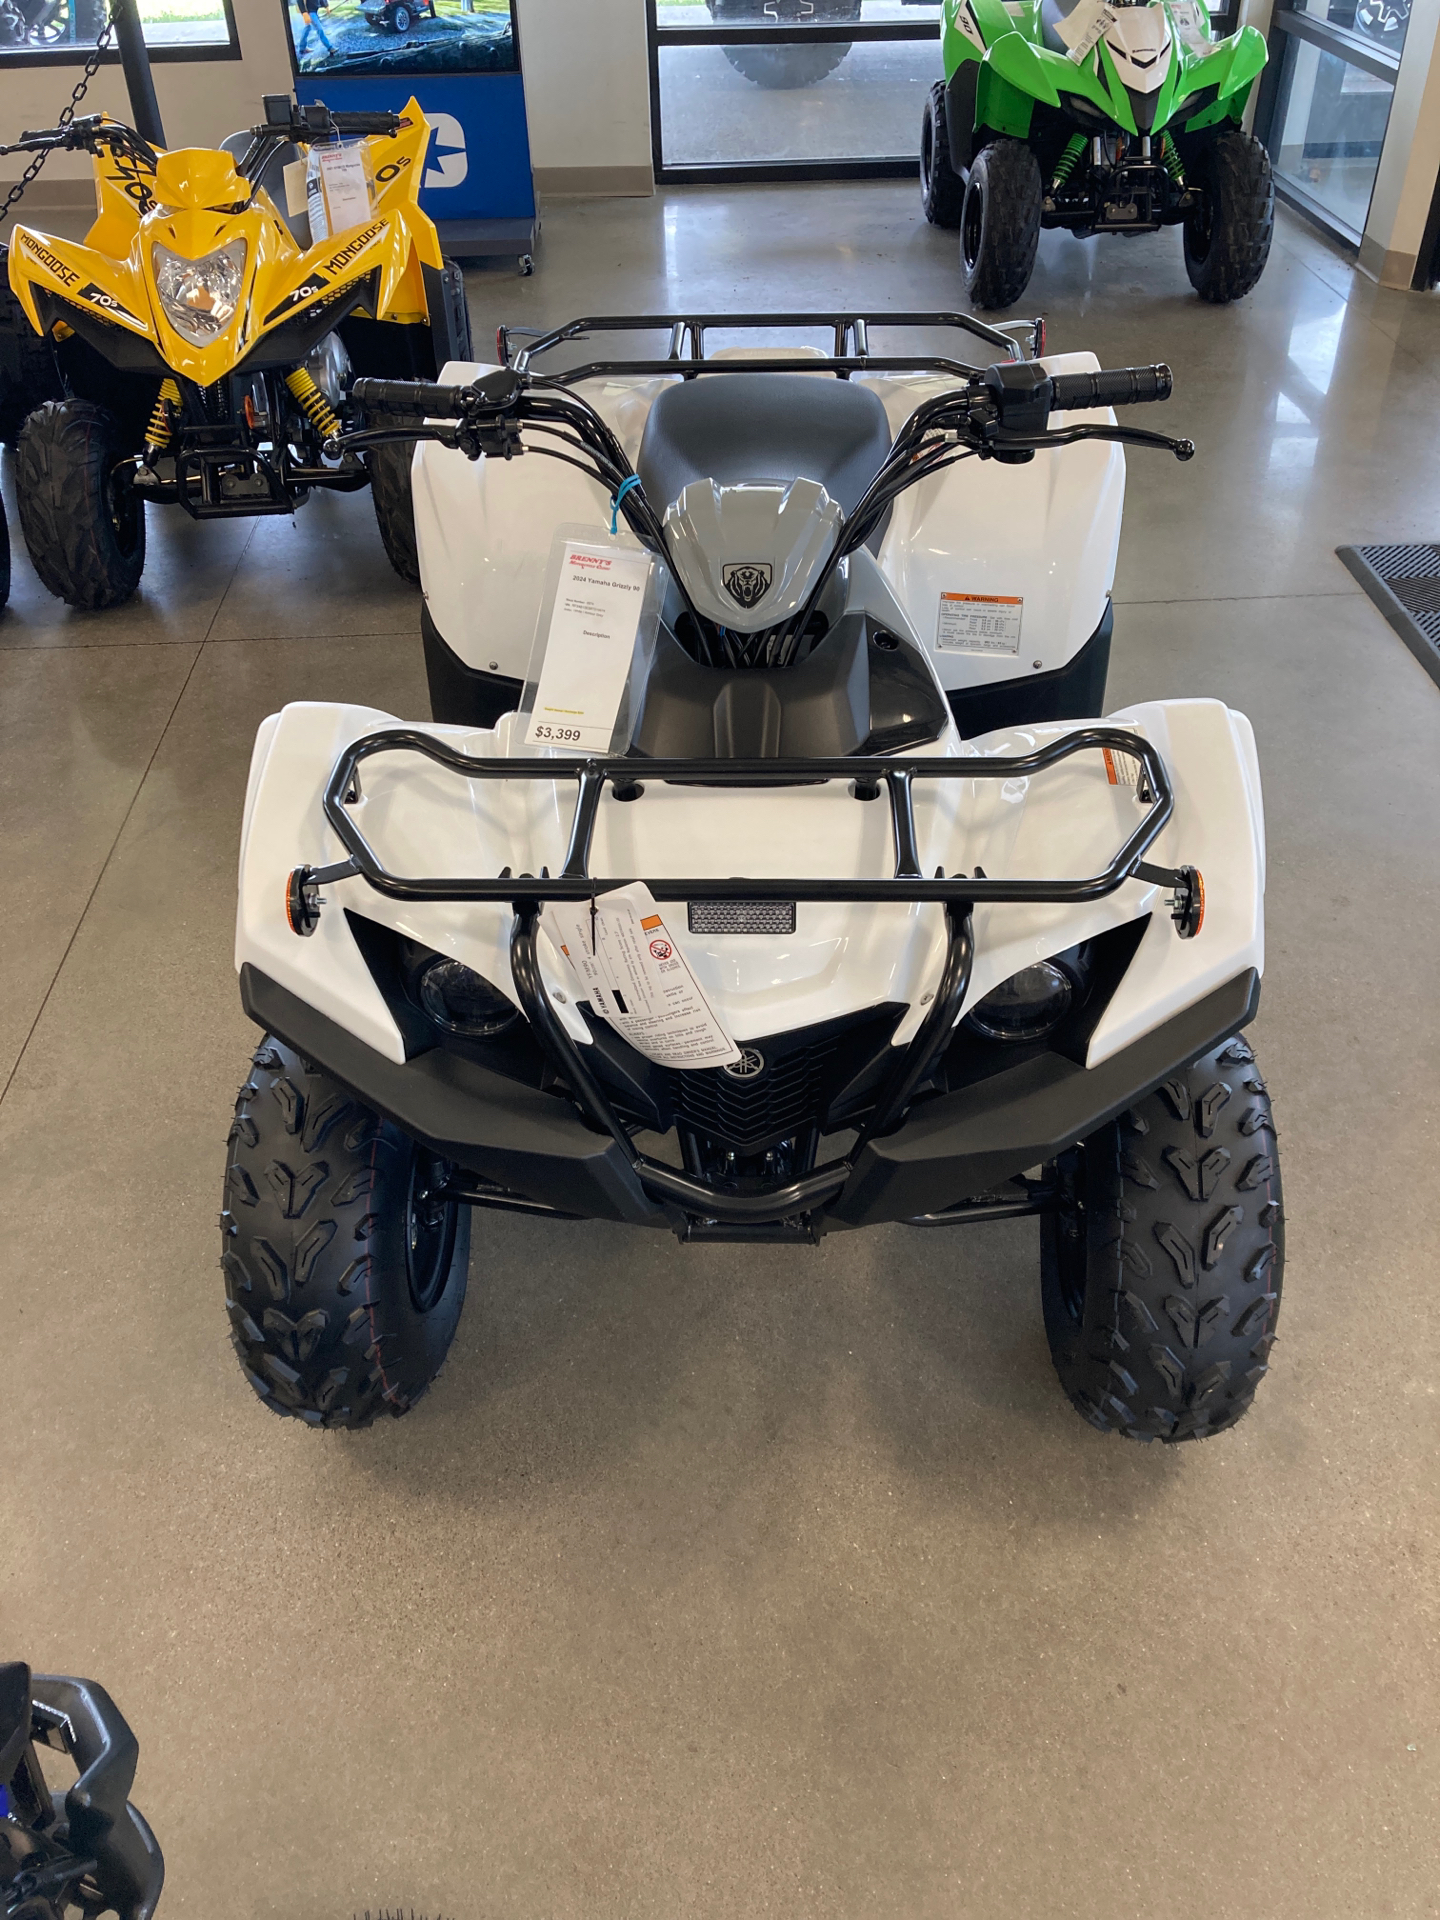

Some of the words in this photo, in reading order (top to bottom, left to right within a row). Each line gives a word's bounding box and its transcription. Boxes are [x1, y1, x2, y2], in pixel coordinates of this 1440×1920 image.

[322, 218, 390, 276] MONGOOSE
[20, 232, 80, 287] MONGOOSE
[572, 574, 586, 582] 2024
[588, 577, 610, 586] Yamaha
[612, 581, 632, 591] Grizzly
[535, 725, 581, 742] $3,399
[592, 986, 607, 1009] YAMAHA
